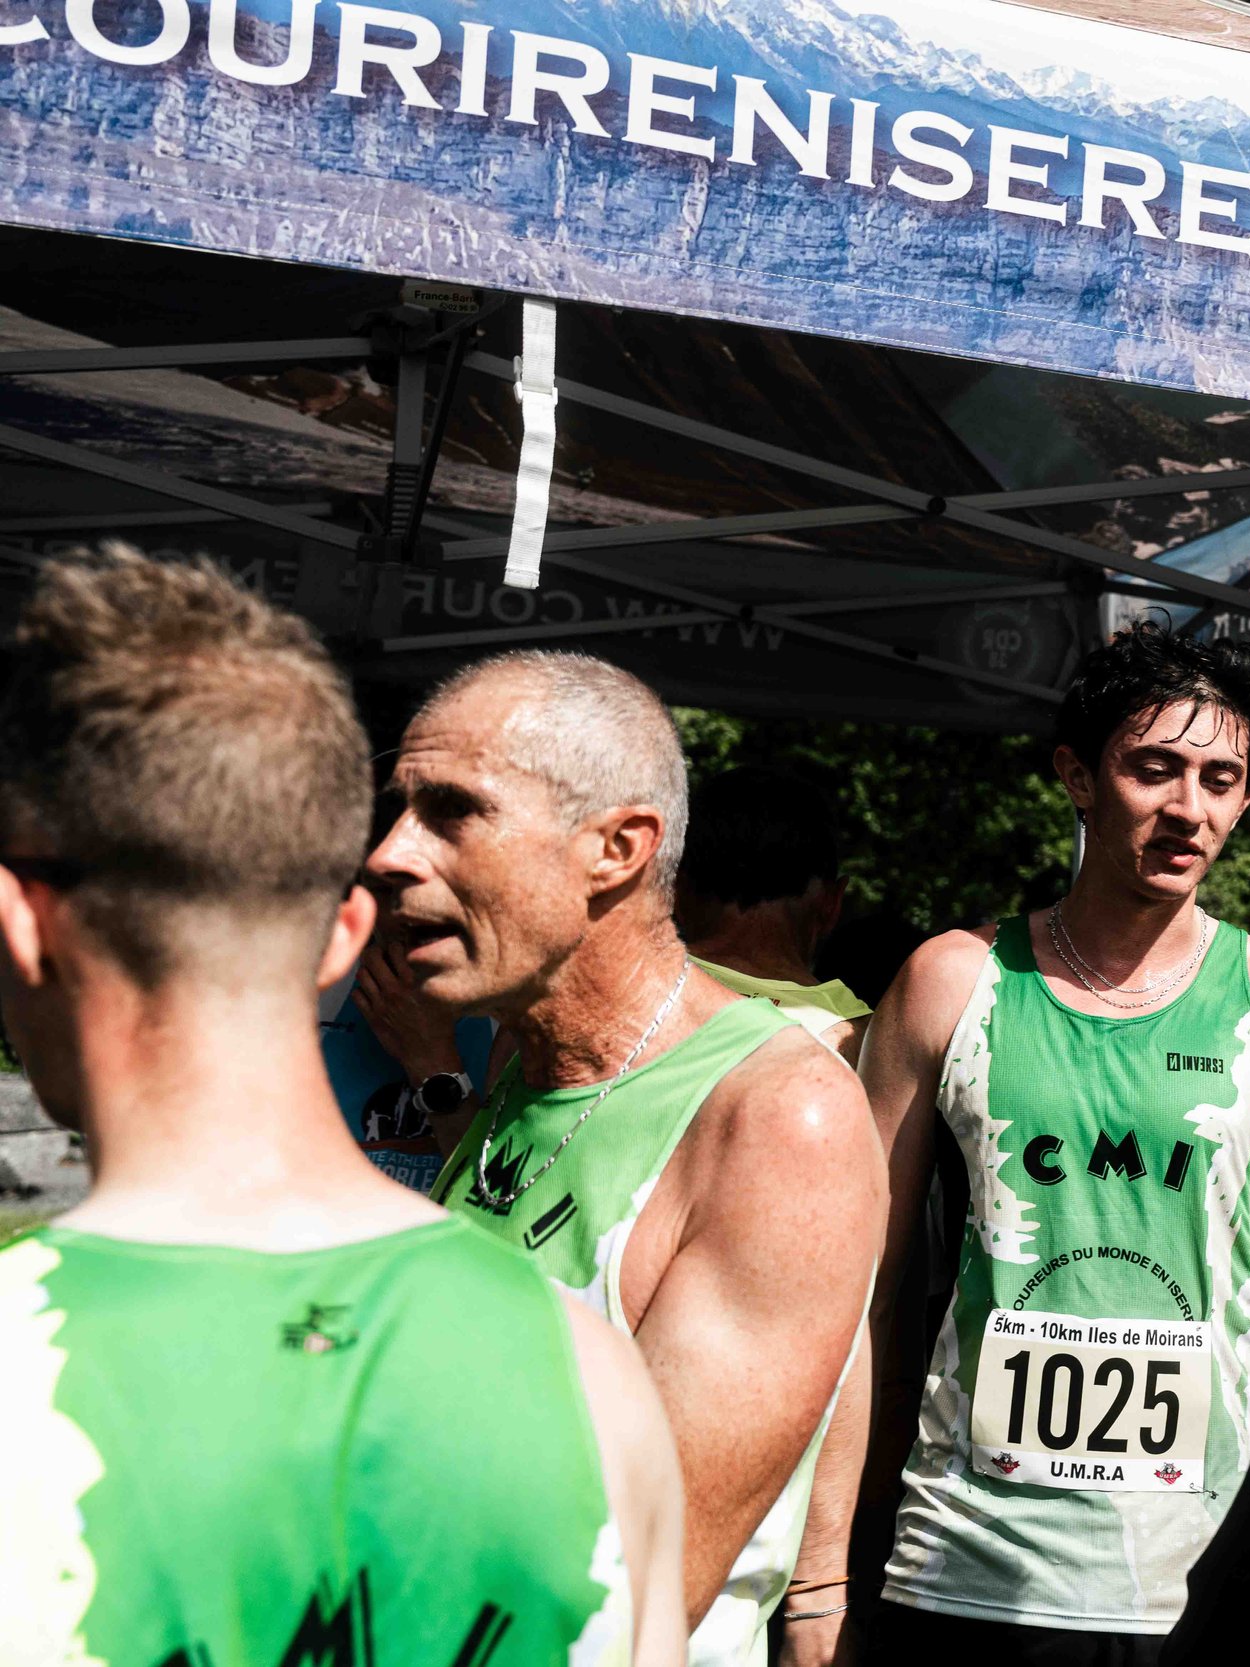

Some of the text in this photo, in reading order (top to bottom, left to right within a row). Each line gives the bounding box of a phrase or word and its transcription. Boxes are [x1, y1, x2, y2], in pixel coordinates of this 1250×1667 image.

[1182, 1055, 1224, 1074] INVERSE
[1022, 1128, 1194, 1192] CMI
[1013, 1253, 1070, 1311] OUREURS
[1072, 1247, 1093, 1262] DU
[1098, 1246, 1151, 1269] MONDE
[1150, 1263, 1170, 1284] EN
[994, 1316, 1025, 1336] 5km
[1040, 1321, 1082, 1342] 10km
[1088, 1326, 1118, 1345] Iles
[1122, 1329, 1141, 1346] de
[1145, 1330, 1203, 1348] Moirans
[1004, 1350, 1181, 1455] 1025
[1050, 1461, 1125, 1481] U.M.R.A
